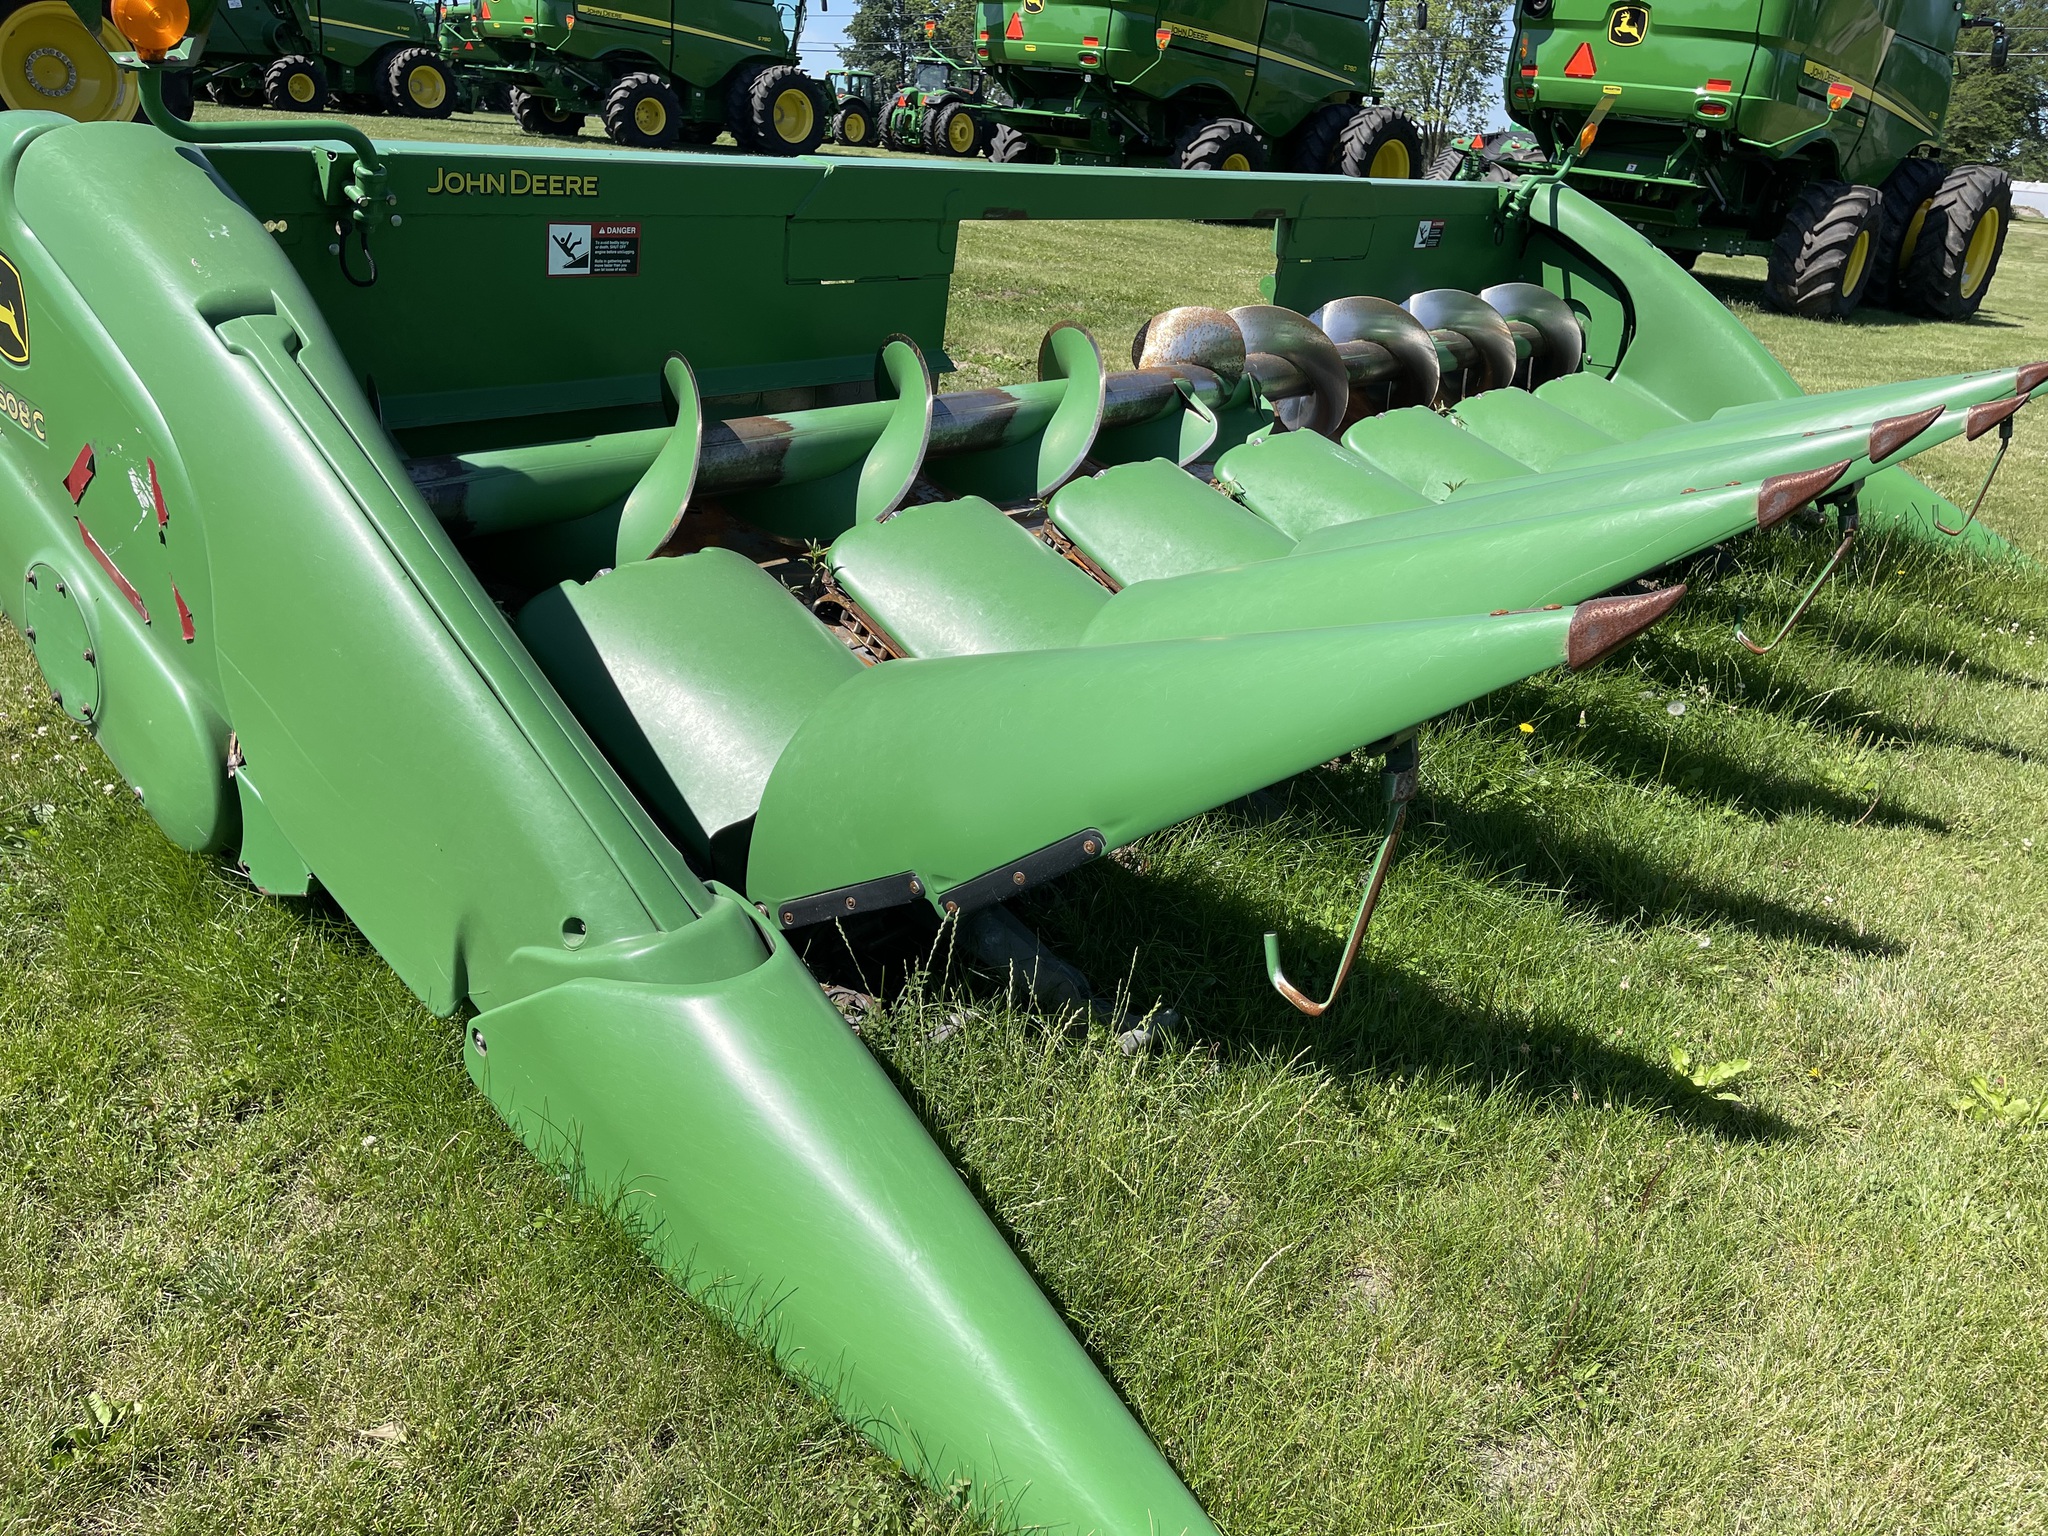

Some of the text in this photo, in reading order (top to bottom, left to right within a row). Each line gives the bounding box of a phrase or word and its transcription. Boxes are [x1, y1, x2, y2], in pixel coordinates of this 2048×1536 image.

[1188, 28, 1209, 41] DEERE
[427, 167, 598, 196] JOHN DEERE
[606, 226, 637, 235] DANGER
